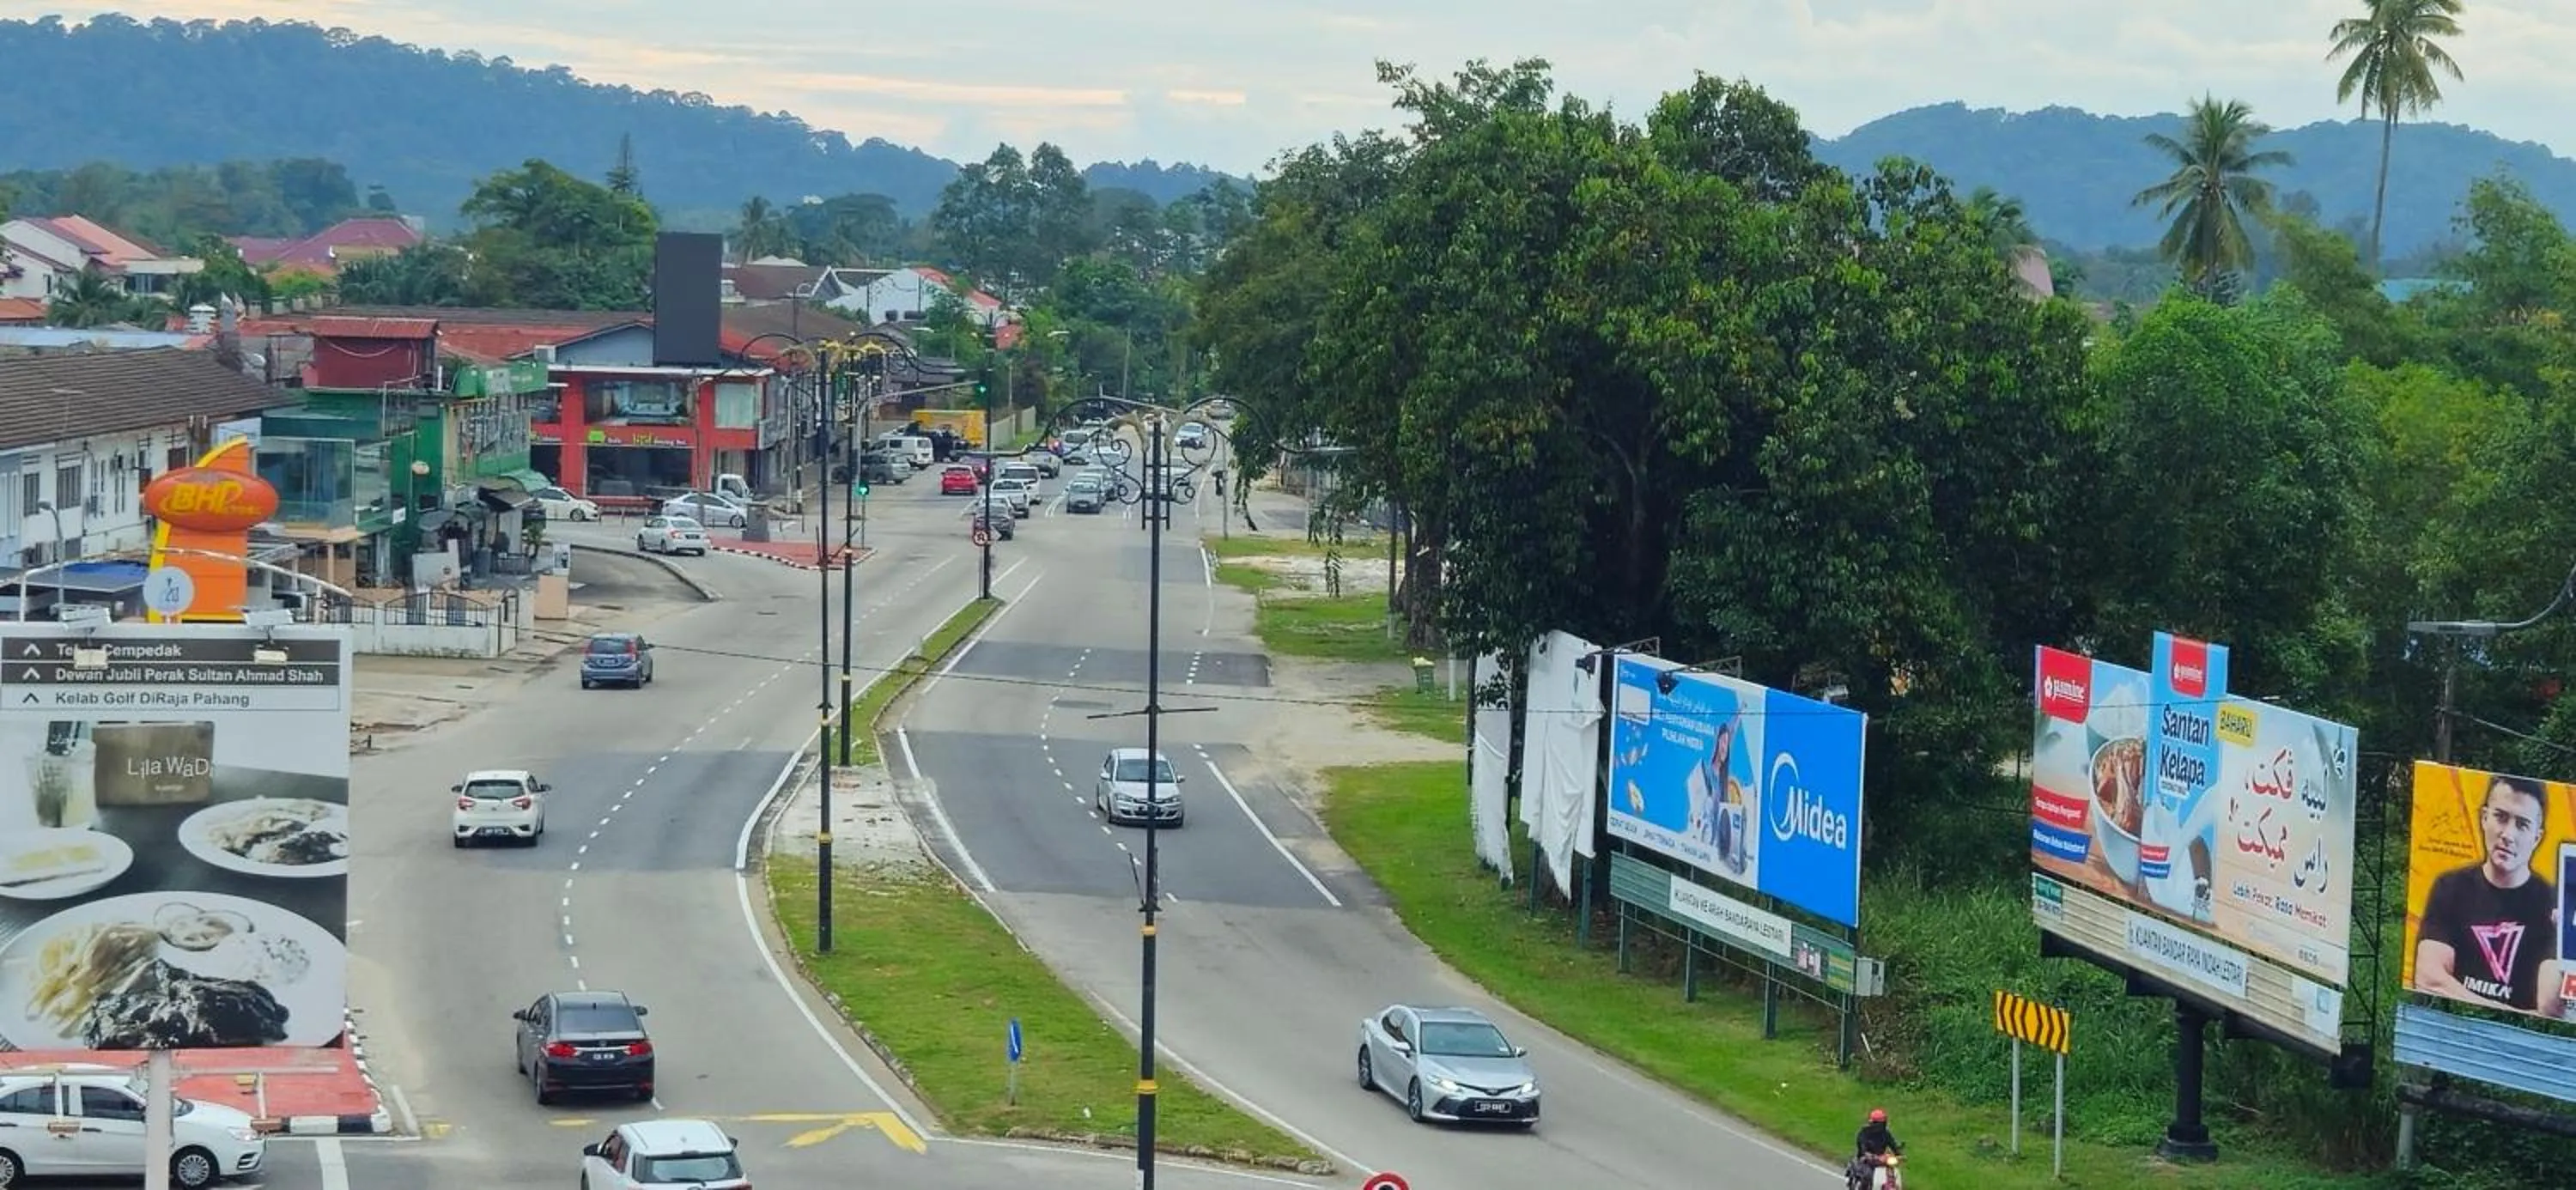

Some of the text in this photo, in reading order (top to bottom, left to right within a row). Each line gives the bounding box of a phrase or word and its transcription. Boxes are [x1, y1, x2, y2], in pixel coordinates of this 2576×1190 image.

[104, 643, 182, 658] Cempedak
[56, 667, 324, 683] Dewan Jubli Perak Sultan Ahmad Shah
[55, 691, 250, 707] Kelab Golf DiRaja Pahang
[2161, 704, 2209, 746] Santan
[2160, 743, 2206, 788] Kelapa
[1769, 751, 1847, 851] Midea
